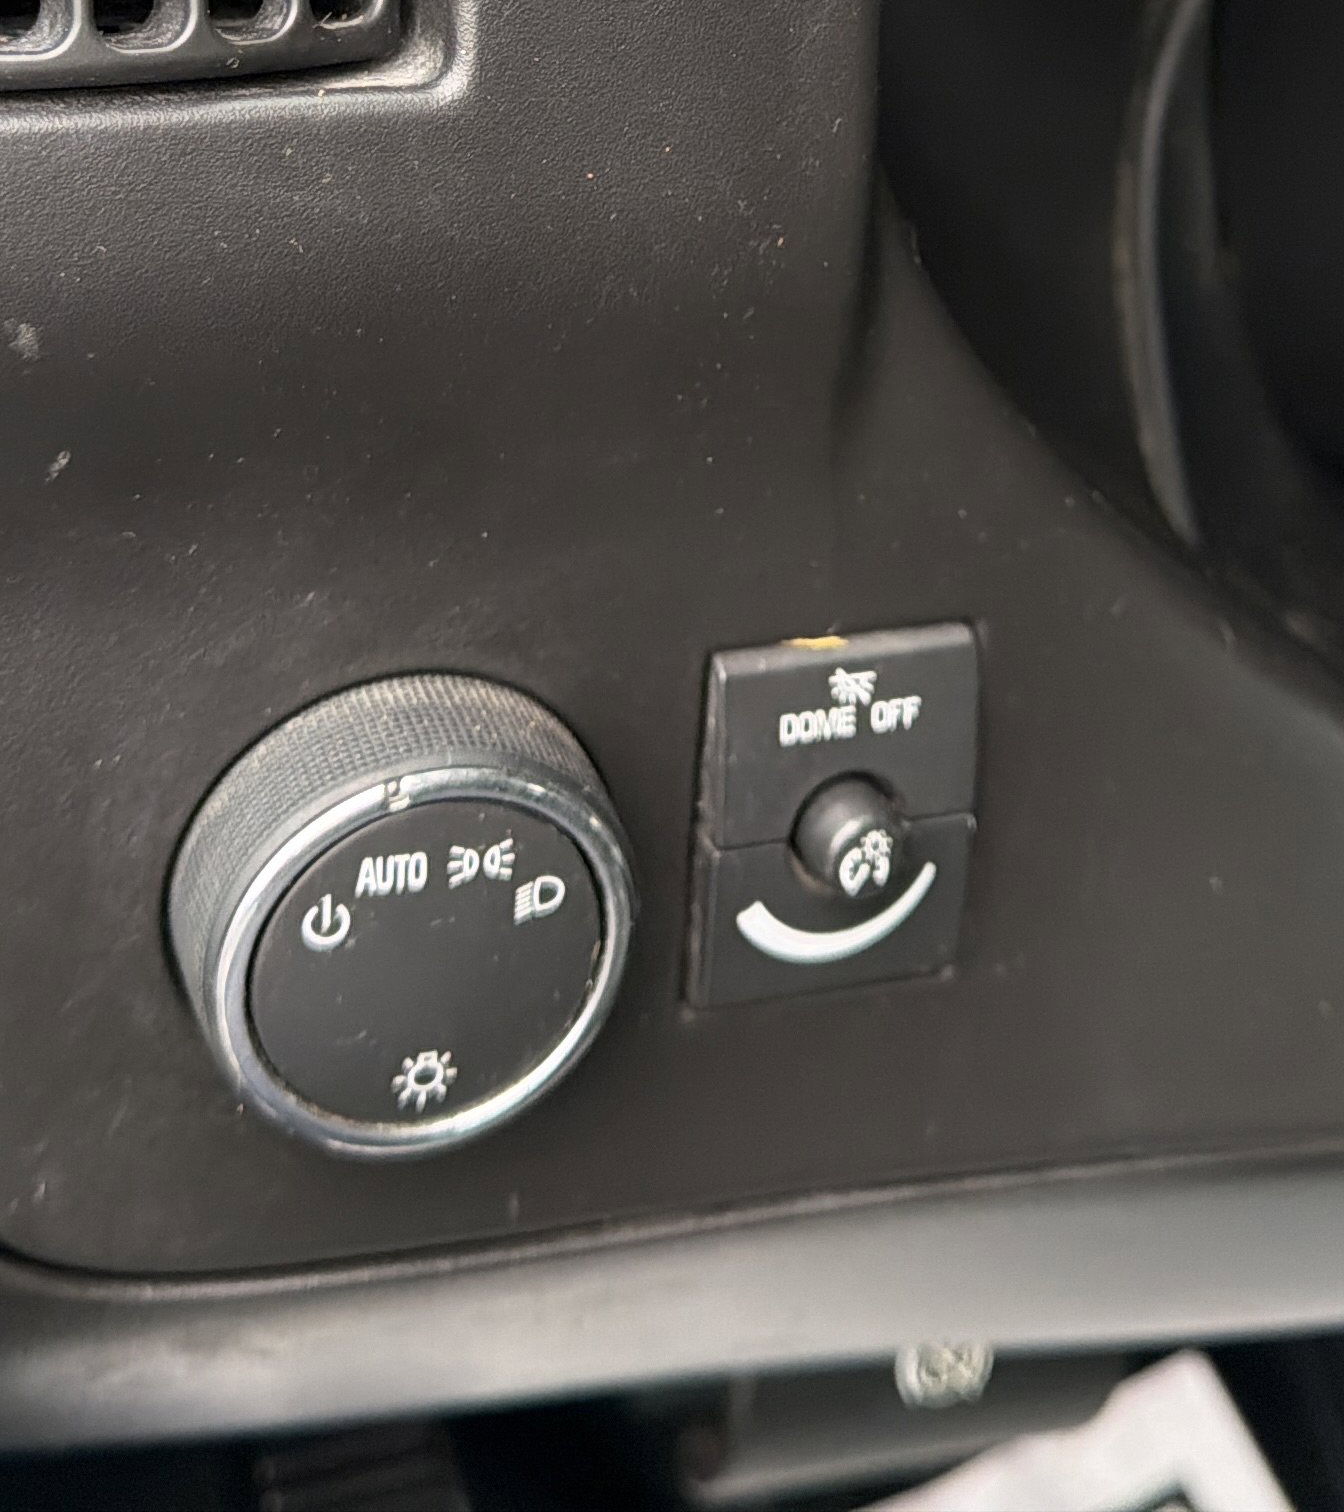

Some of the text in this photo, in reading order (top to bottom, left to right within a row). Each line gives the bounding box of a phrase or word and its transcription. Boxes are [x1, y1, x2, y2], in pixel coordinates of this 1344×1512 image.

[779, 695, 922, 748] DOME OFF
[354, 841, 428, 899] AUTO
